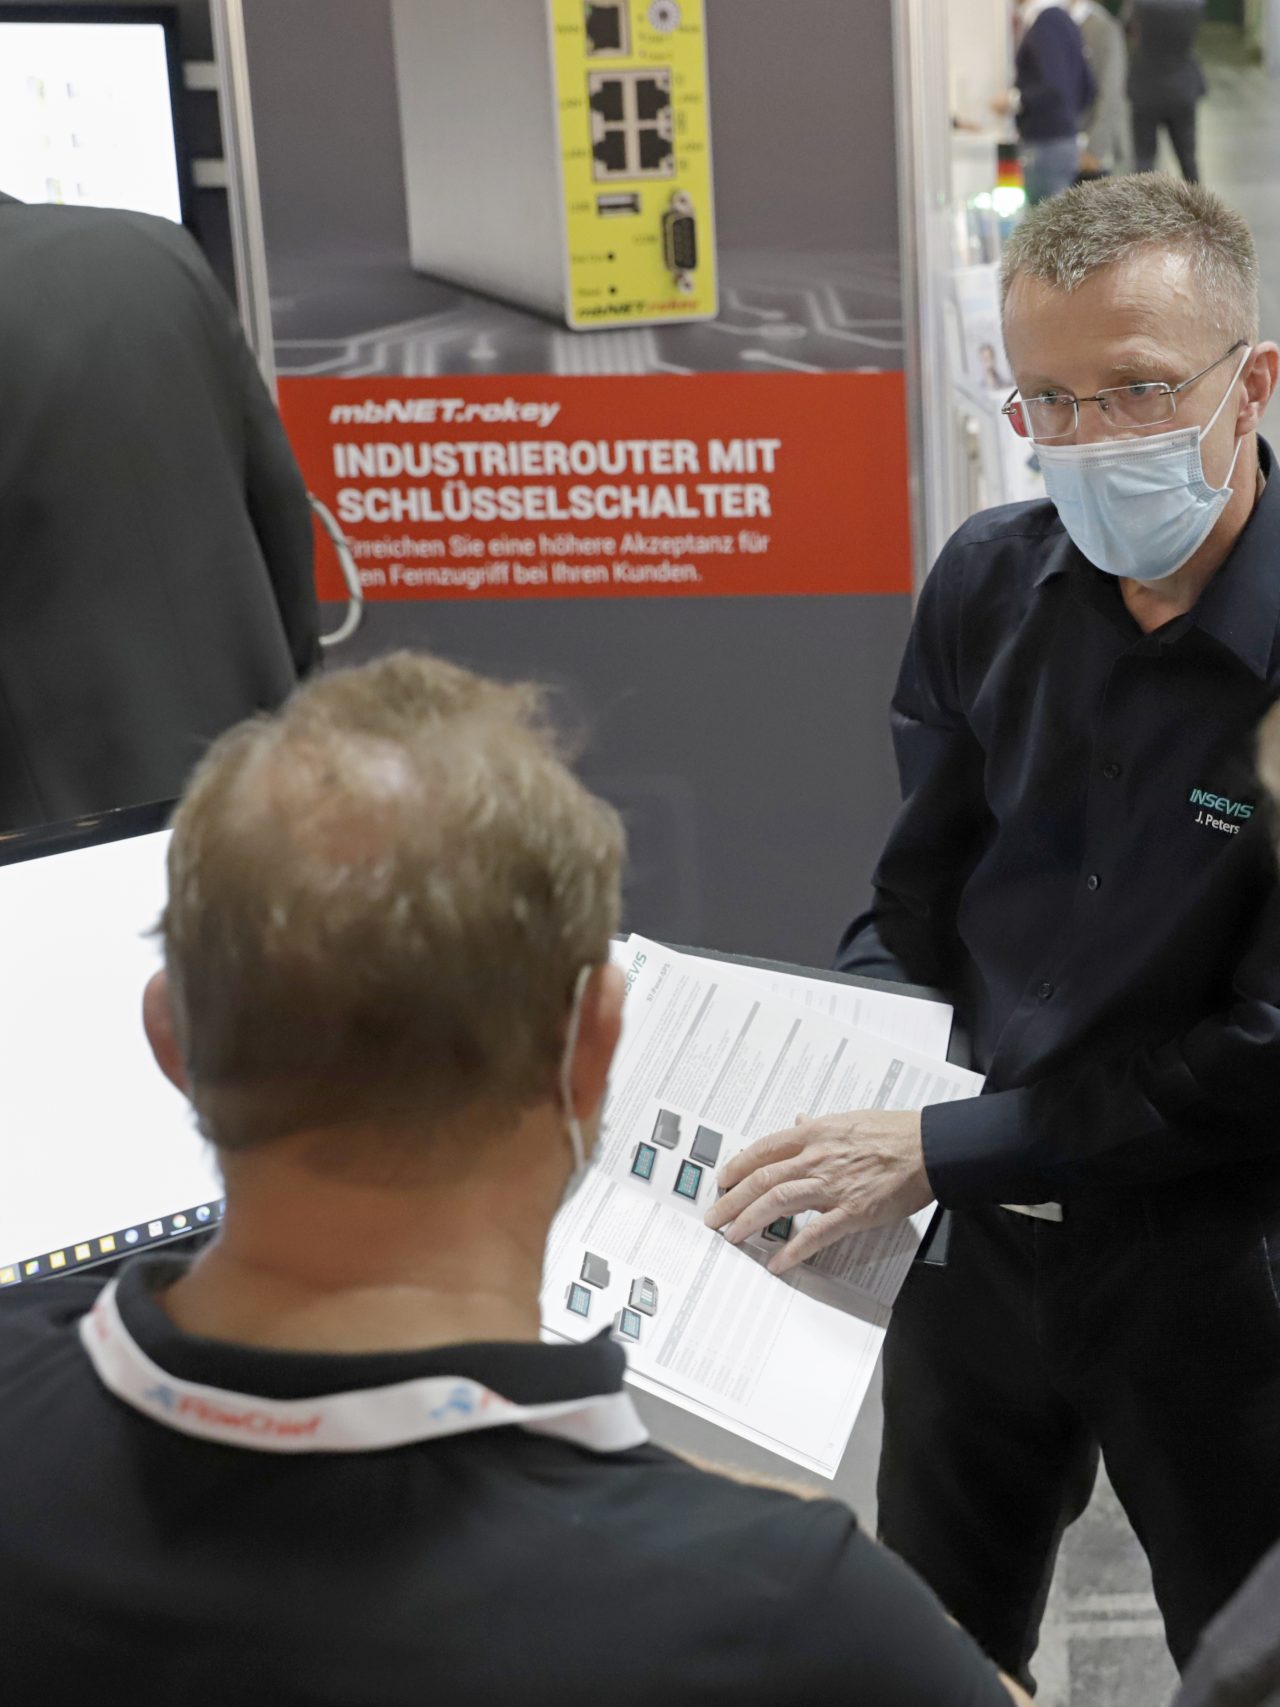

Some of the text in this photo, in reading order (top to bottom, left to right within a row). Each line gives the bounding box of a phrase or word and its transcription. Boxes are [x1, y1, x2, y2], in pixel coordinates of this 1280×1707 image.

[333, 438, 782, 478] INDUSTRIEROUTER MIT
[336, 479, 772, 523] SCHLÜSSELSCHALTER
[448, 533, 485, 558] Sie
[487, 533, 536, 557] eine
[538, 532, 617, 556] höhere
[620, 531, 735, 558] Akzeptanz
[737, 529, 770, 554] für
[389, 561, 510, 590] Fernzugriff
[512, 560, 548, 584] bei
[551, 560, 609, 584] Ihren
[612, 558, 704, 583] Kunden.
[1189, 788, 1254, 818] INSEVIS
[1195, 810, 1241, 835] J. Peters
[624, 951, 647, 1001] SEVIS
